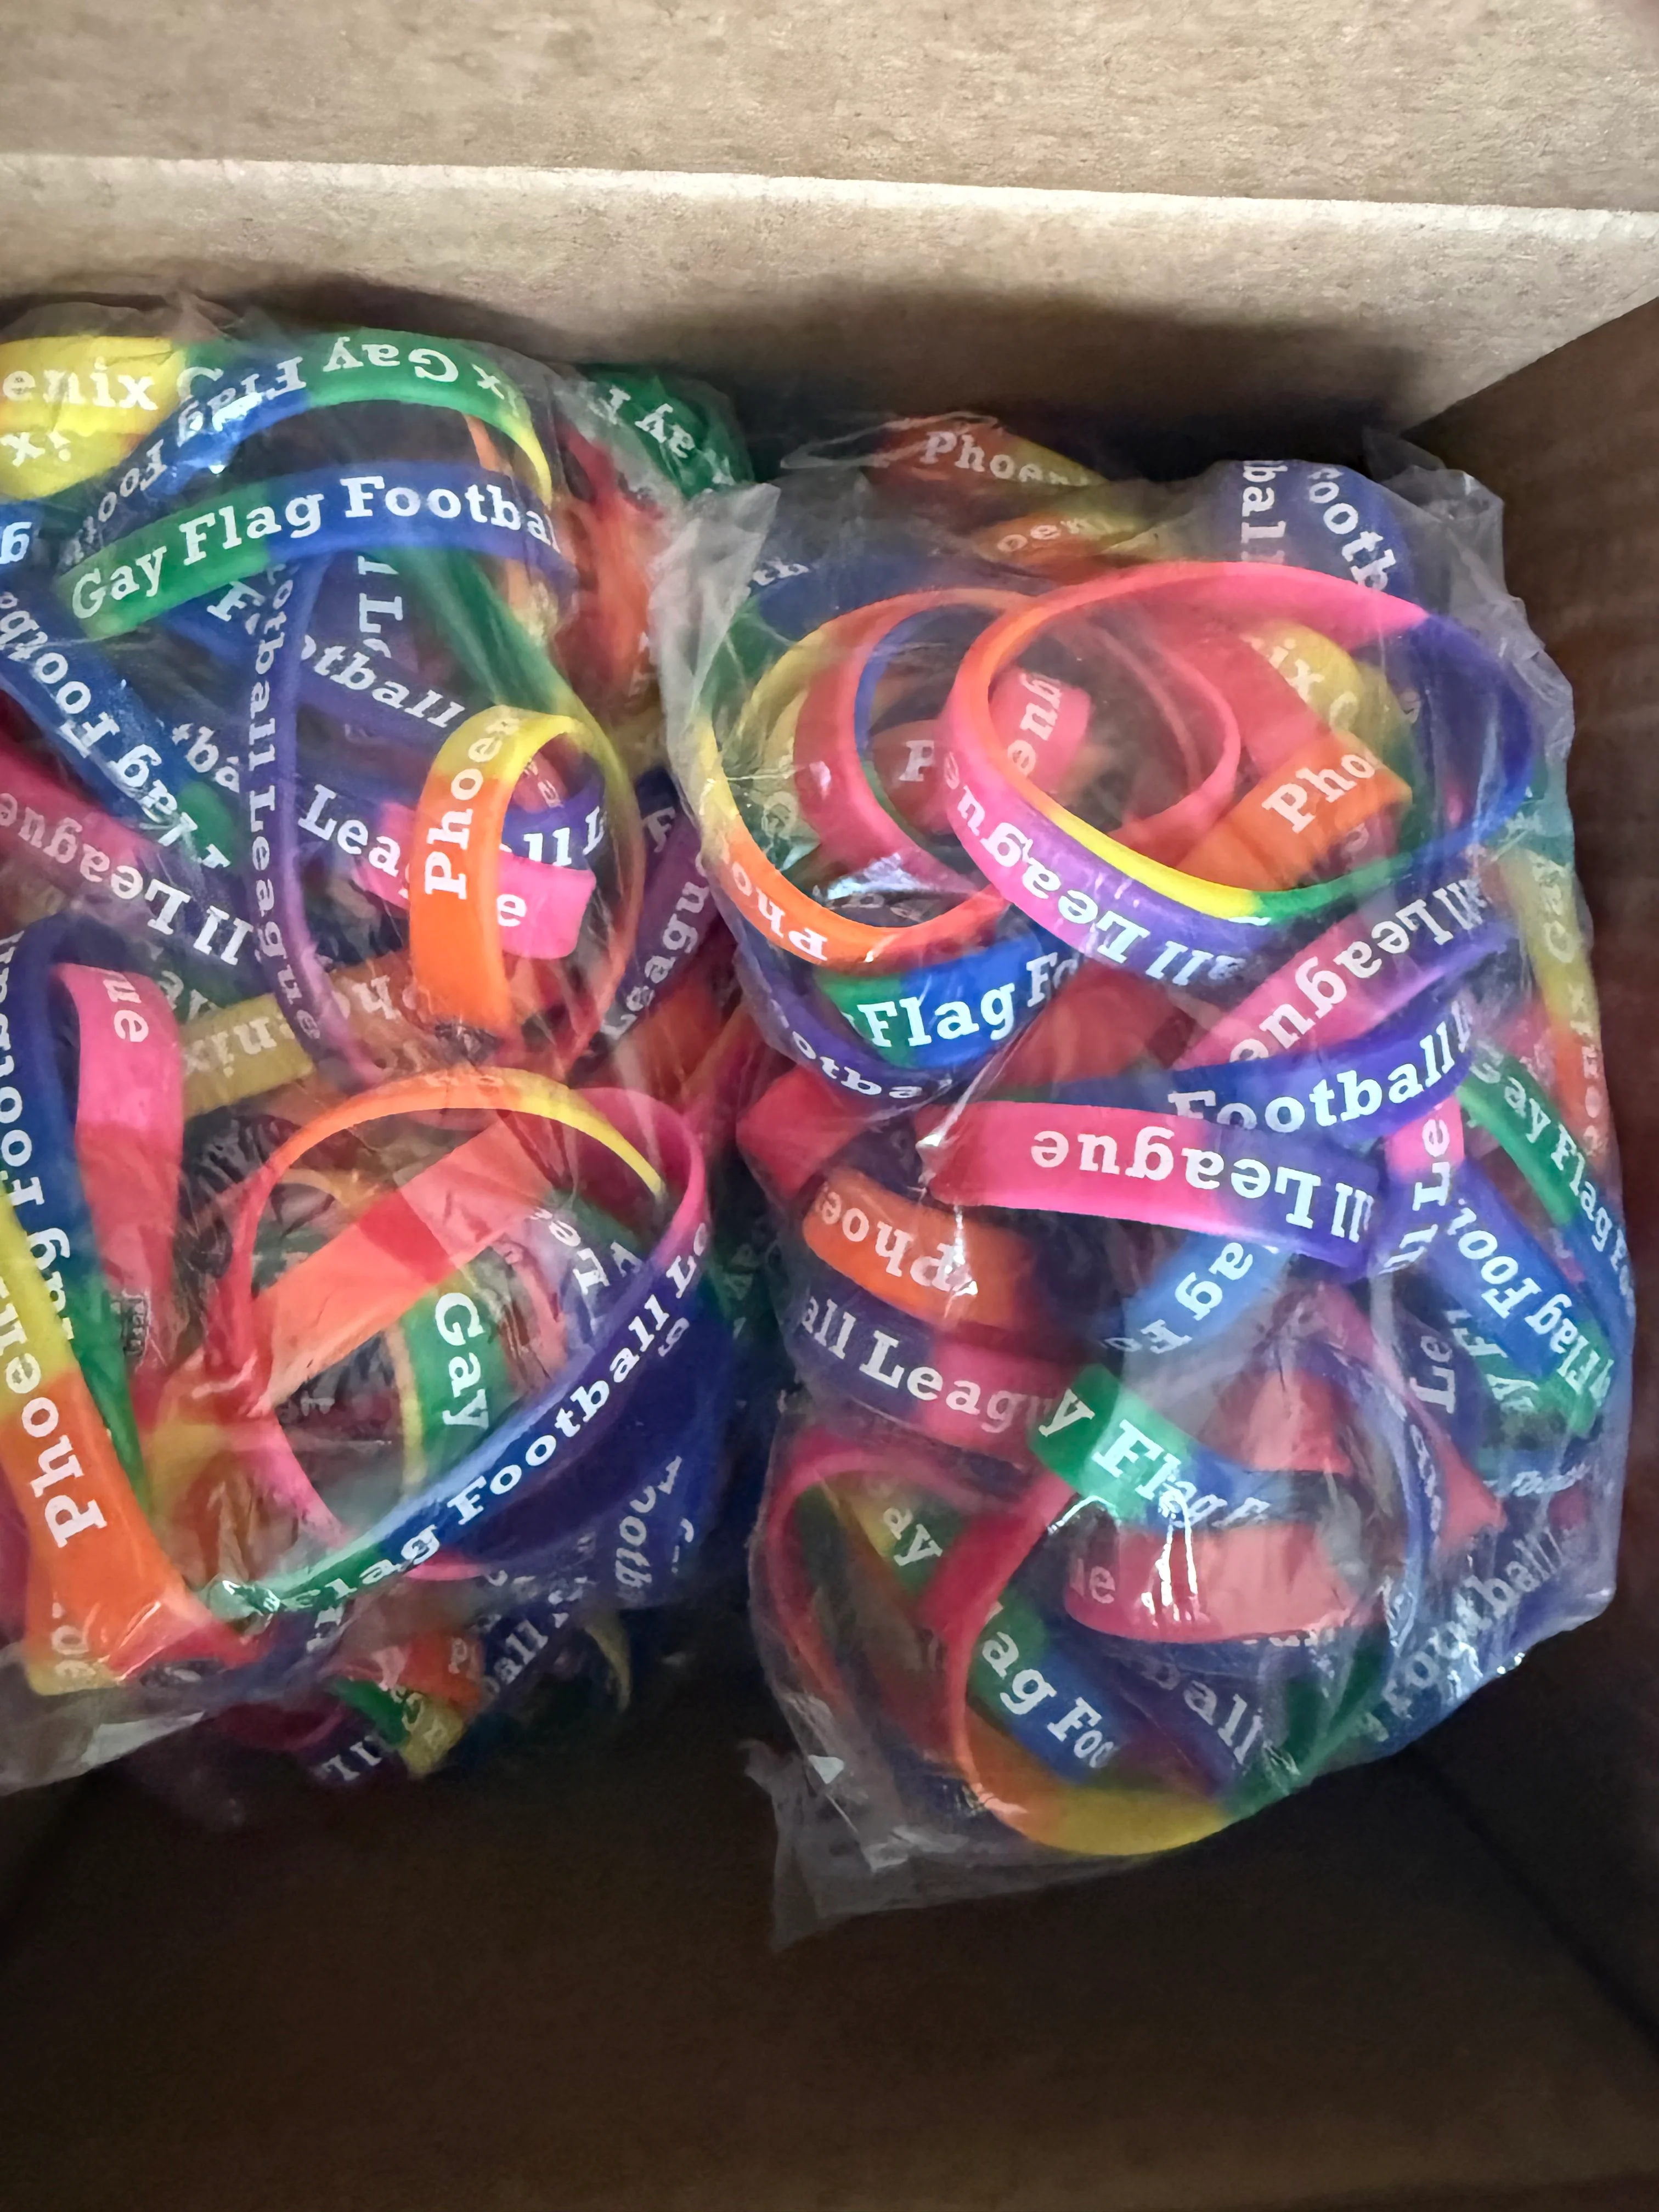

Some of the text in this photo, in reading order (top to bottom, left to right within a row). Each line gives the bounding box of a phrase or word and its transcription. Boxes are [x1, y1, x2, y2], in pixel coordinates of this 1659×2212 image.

[323, 336, 459, 383] Gay
[71, 545, 167, 619] Gay
[179, 493, 325, 566] Flag
[0, 793, 191, 935] League
[249, 785, 321, 1041] League
[944, 752, 1151, 964] League
[857, 983, 1017, 1048] Flag
[1031, 1125, 1322, 1230] League
[1550, 1124, 1614, 1252] Flag
[434, 1292, 489, 1429] Gay
[447, 1294, 670, 1526] Football
